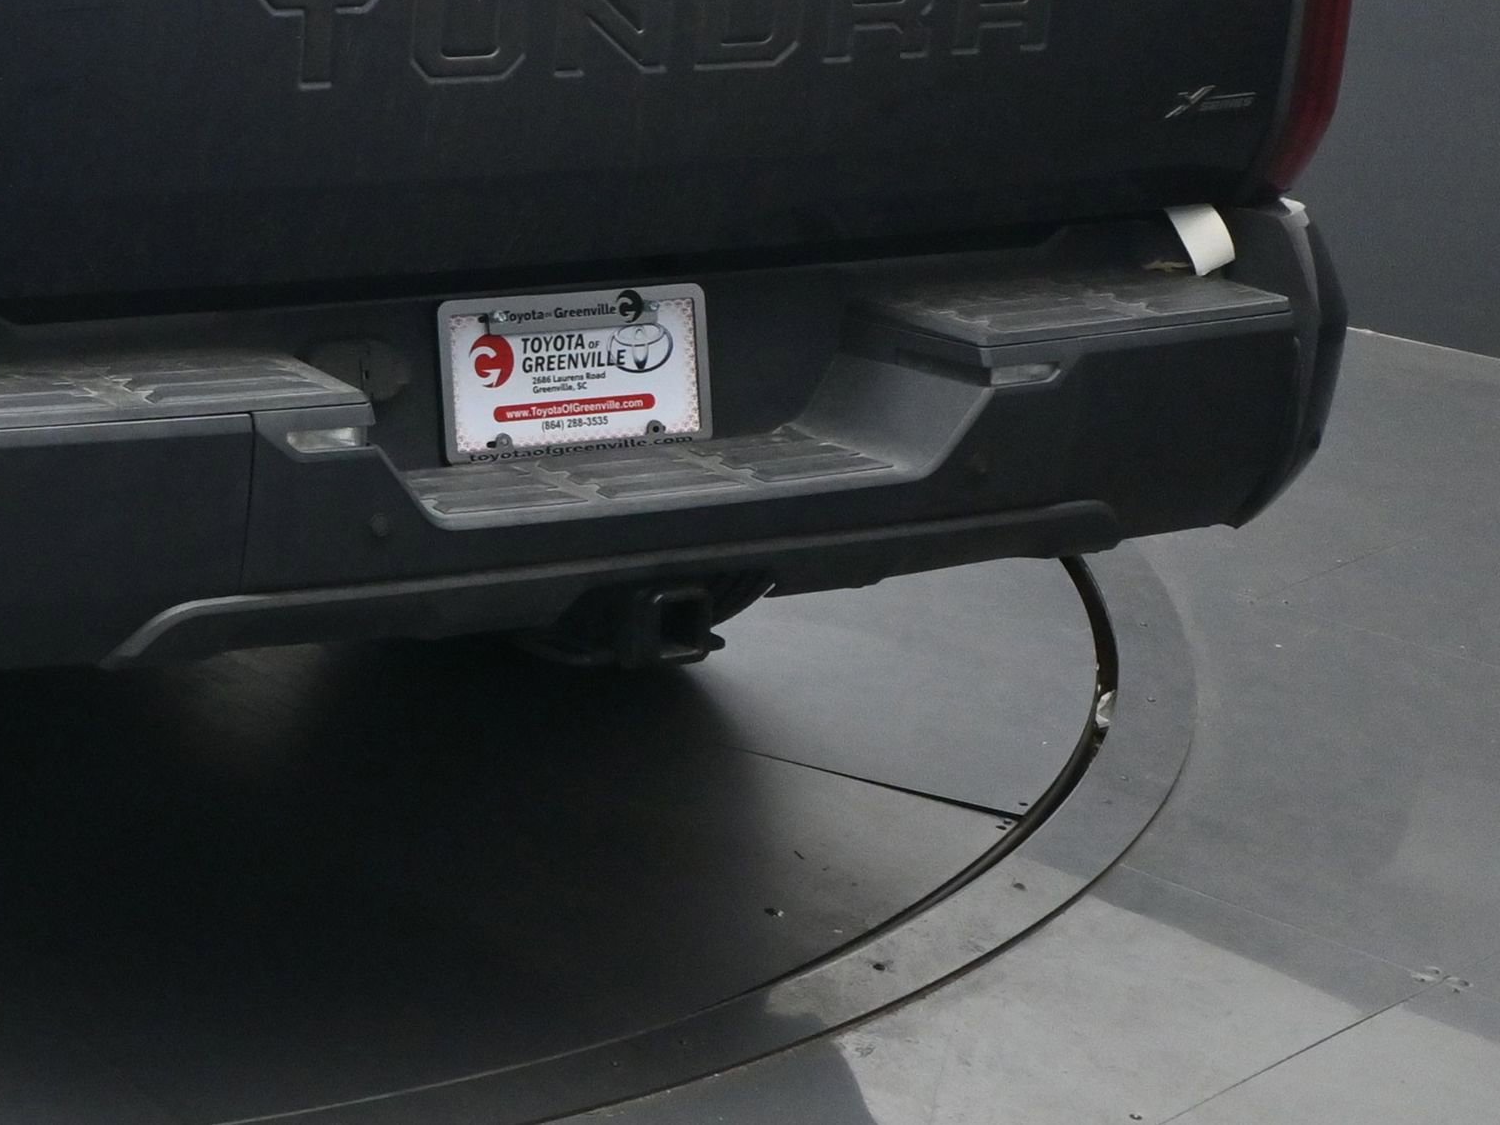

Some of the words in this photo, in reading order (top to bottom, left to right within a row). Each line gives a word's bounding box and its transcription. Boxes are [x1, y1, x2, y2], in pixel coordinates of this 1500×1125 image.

[503, 309, 545, 324] Toyota
[554, 303, 617, 319] Greenville
[521, 334, 585, 354] TOYOTA
[588, 340, 600, 349] OF
[522, 349, 627, 373] GREENVILLE
[553, 373, 584, 383] Laurens
[586, 371, 606, 380] Road
[532, 383, 576, 394] Greenville,
[577, 382, 588, 390] SC
[506, 399, 644, 419] www.ToyotaOfGreenville.com
[541, 420, 565, 433] (864)
[469, 435, 694, 463] toyotaofgreenville.com
